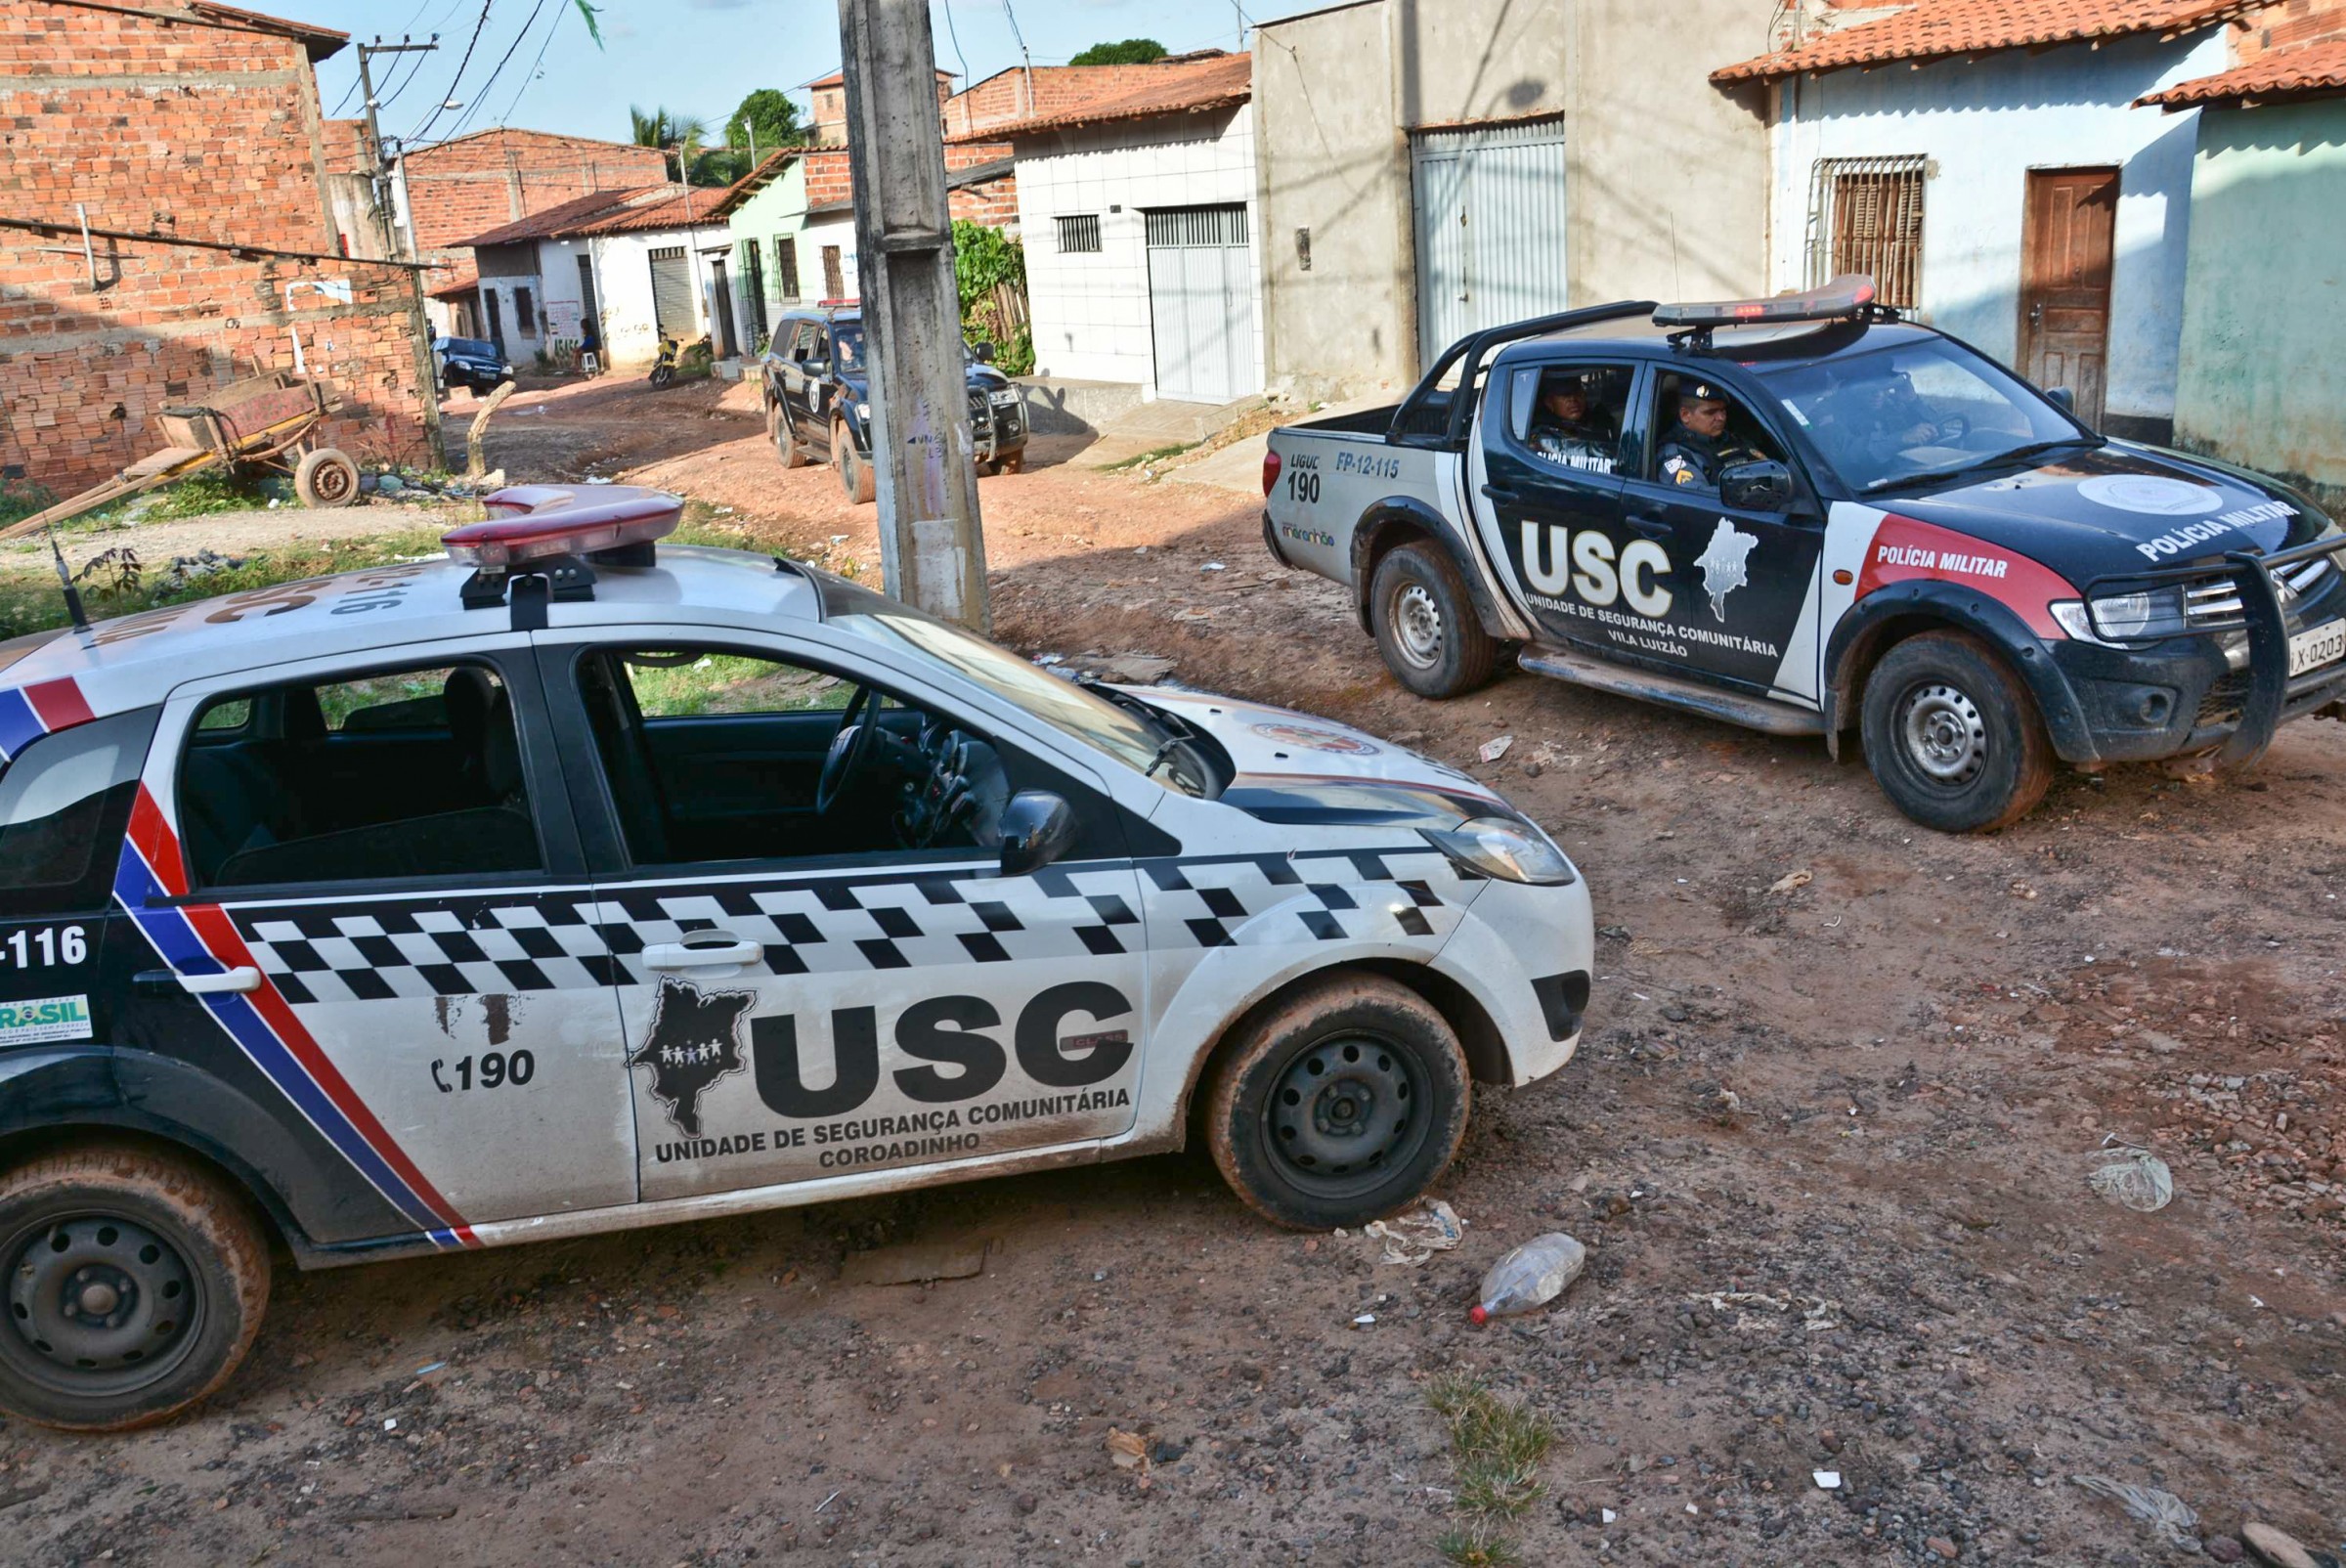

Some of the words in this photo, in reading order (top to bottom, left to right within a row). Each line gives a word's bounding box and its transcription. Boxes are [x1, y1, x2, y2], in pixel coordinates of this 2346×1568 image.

[1336, 452, 1400, 479] FP-12-115
[1287, 470, 1321, 503] 190
[2135, 519, 2232, 562] POLÍCIA
[2218, 501, 2301, 528] MILITAR
[1521, 520, 1673, 618] USC
[1877, 544, 1936, 569] POLÍCIA
[1938, 552, 2008, 578] MILITAR
[1525, 592, 1577, 615] UNIDADE
[1579, 605, 1595, 620] DE
[1598, 609, 1676, 637] SEGURANÇA
[1678, 626, 1779, 658] COMUNITÁRIA
[1639, 636, 1688, 657] LUIZÃO
[2290, 633, 2343, 673] X-0203
[750, 980, 1134, 1118] USC
[456, 1049, 535, 1091] 190
[655, 1132, 766, 1163] UNIDADE
[774, 1127, 805, 1150] DE
[813, 1110, 961, 1145] SEGURANÇA
[968, 1087, 1131, 1125] COMUNITÁRIA
[819, 1132, 980, 1169] COROADINHO
